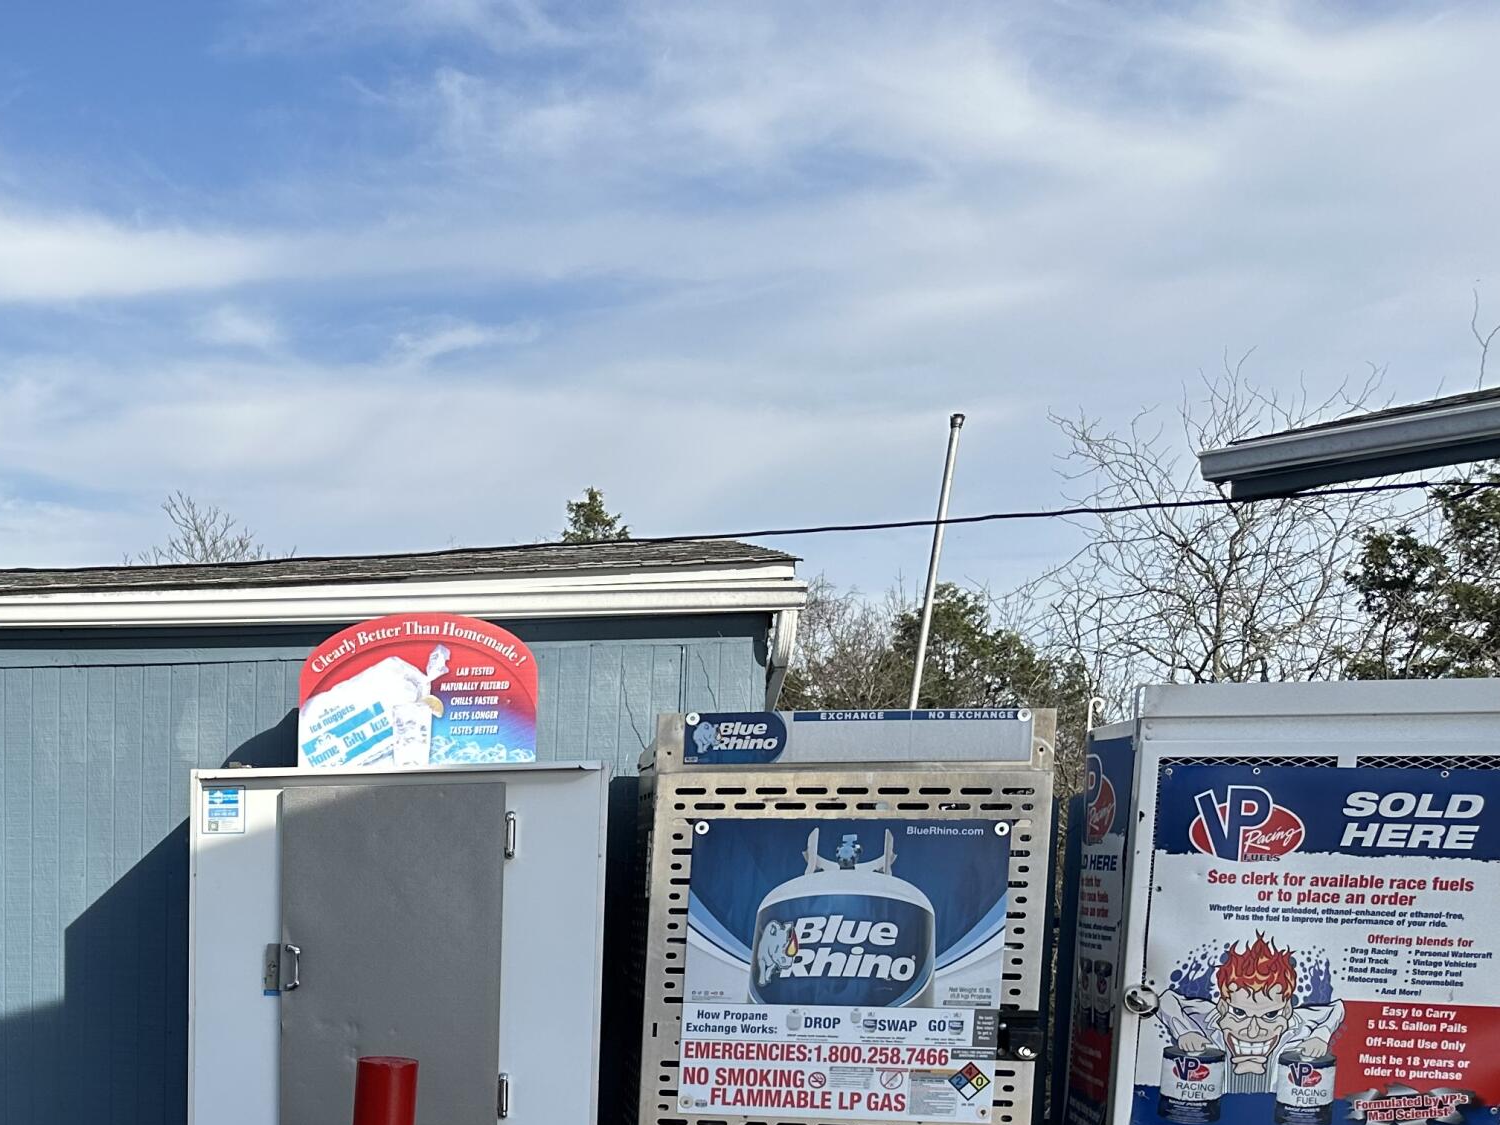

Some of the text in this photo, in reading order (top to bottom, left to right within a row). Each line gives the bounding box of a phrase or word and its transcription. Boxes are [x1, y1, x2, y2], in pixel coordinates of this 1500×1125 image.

[311, 637, 357, 673] Clearly
[357, 626, 401, 645] Better
[403, 621, 440, 636] Than
[456, 667, 494, 676] LAB TESTED
[441, 681, 509, 691] NATURALLY FILTERED
[451, 696, 498, 705] CHILLS FASTER
[450, 711, 498, 720] LASTS LONGER
[820, 712, 884, 720] EXCHANGE
[950, 711, 1014, 719] EXCHANGE
[450, 726, 498, 735] TASTES BETTER
[719, 722, 767, 735] Blue
[308, 717, 389, 767] Home City Ice
[713, 736, 778, 750] Rhino
[1343, 792, 1484, 818] SOLD
[1194, 785, 1273, 862] VP
[907, 826, 983, 836] BlueRhino.com
[1340, 823, 1480, 849] HERE
[1244, 826, 1302, 852] Racing
[1090, 855, 1117, 871] HERE
[1208, 869, 1474, 891] See clerk for available race fuels
[1258, 889, 1416, 905] or to place an order
[1209, 904, 1242, 912] Whether
[1321, 909, 1396, 917] ethanol-enhanced
[795, 915, 898, 946] Blue
[1367, 934, 1474, 947] Offering blends for
[1350, 947, 1398, 956] Drag Racing
[780, 946, 915, 981] Rhino
[1413, 959, 1442, 968] Vintage
[1370, 967, 1397, 975] Racing
[1412, 969, 1443, 977] Storage
[1411, 978, 1464, 986] Snowmobiles
[697, 1010, 768, 1022] How Propane
[1382, 1006, 1456, 1020] Easy to Carry
[686, 1023, 778, 1035] Exchange Works:
[804, 1017, 840, 1029] DROP
[878, 1020, 917, 1031] SWAP
[928, 1020, 946, 1031] GO
[1368, 1020, 1467, 1033] 5 U.S. Gallon Pails
[1366, 1037, 1466, 1052] Off-Road Use Only
[1359, 1054, 1470, 1068] Must be 18 years or
[965, 1066, 974, 1077] 4
[1174, 1057, 1200, 1081] VP
[1364, 1067, 1462, 1080] older to purchase
[683, 1067, 804, 1088] NO SMOKING
[955, 1076, 984, 1086] 2 0
[1176, 1082, 1215, 1092] RACING
[710, 1088, 832, 1109] FLAMMABLE
[838, 1092, 861, 1110] LP
[867, 1092, 906, 1112] GAS
[1182, 1091, 1204, 1099] FUEL
[1355, 1096, 1422, 1110] Formulated
[1424, 1095, 1438, 1106] by
[1368, 1109, 1393, 1121] Mad
